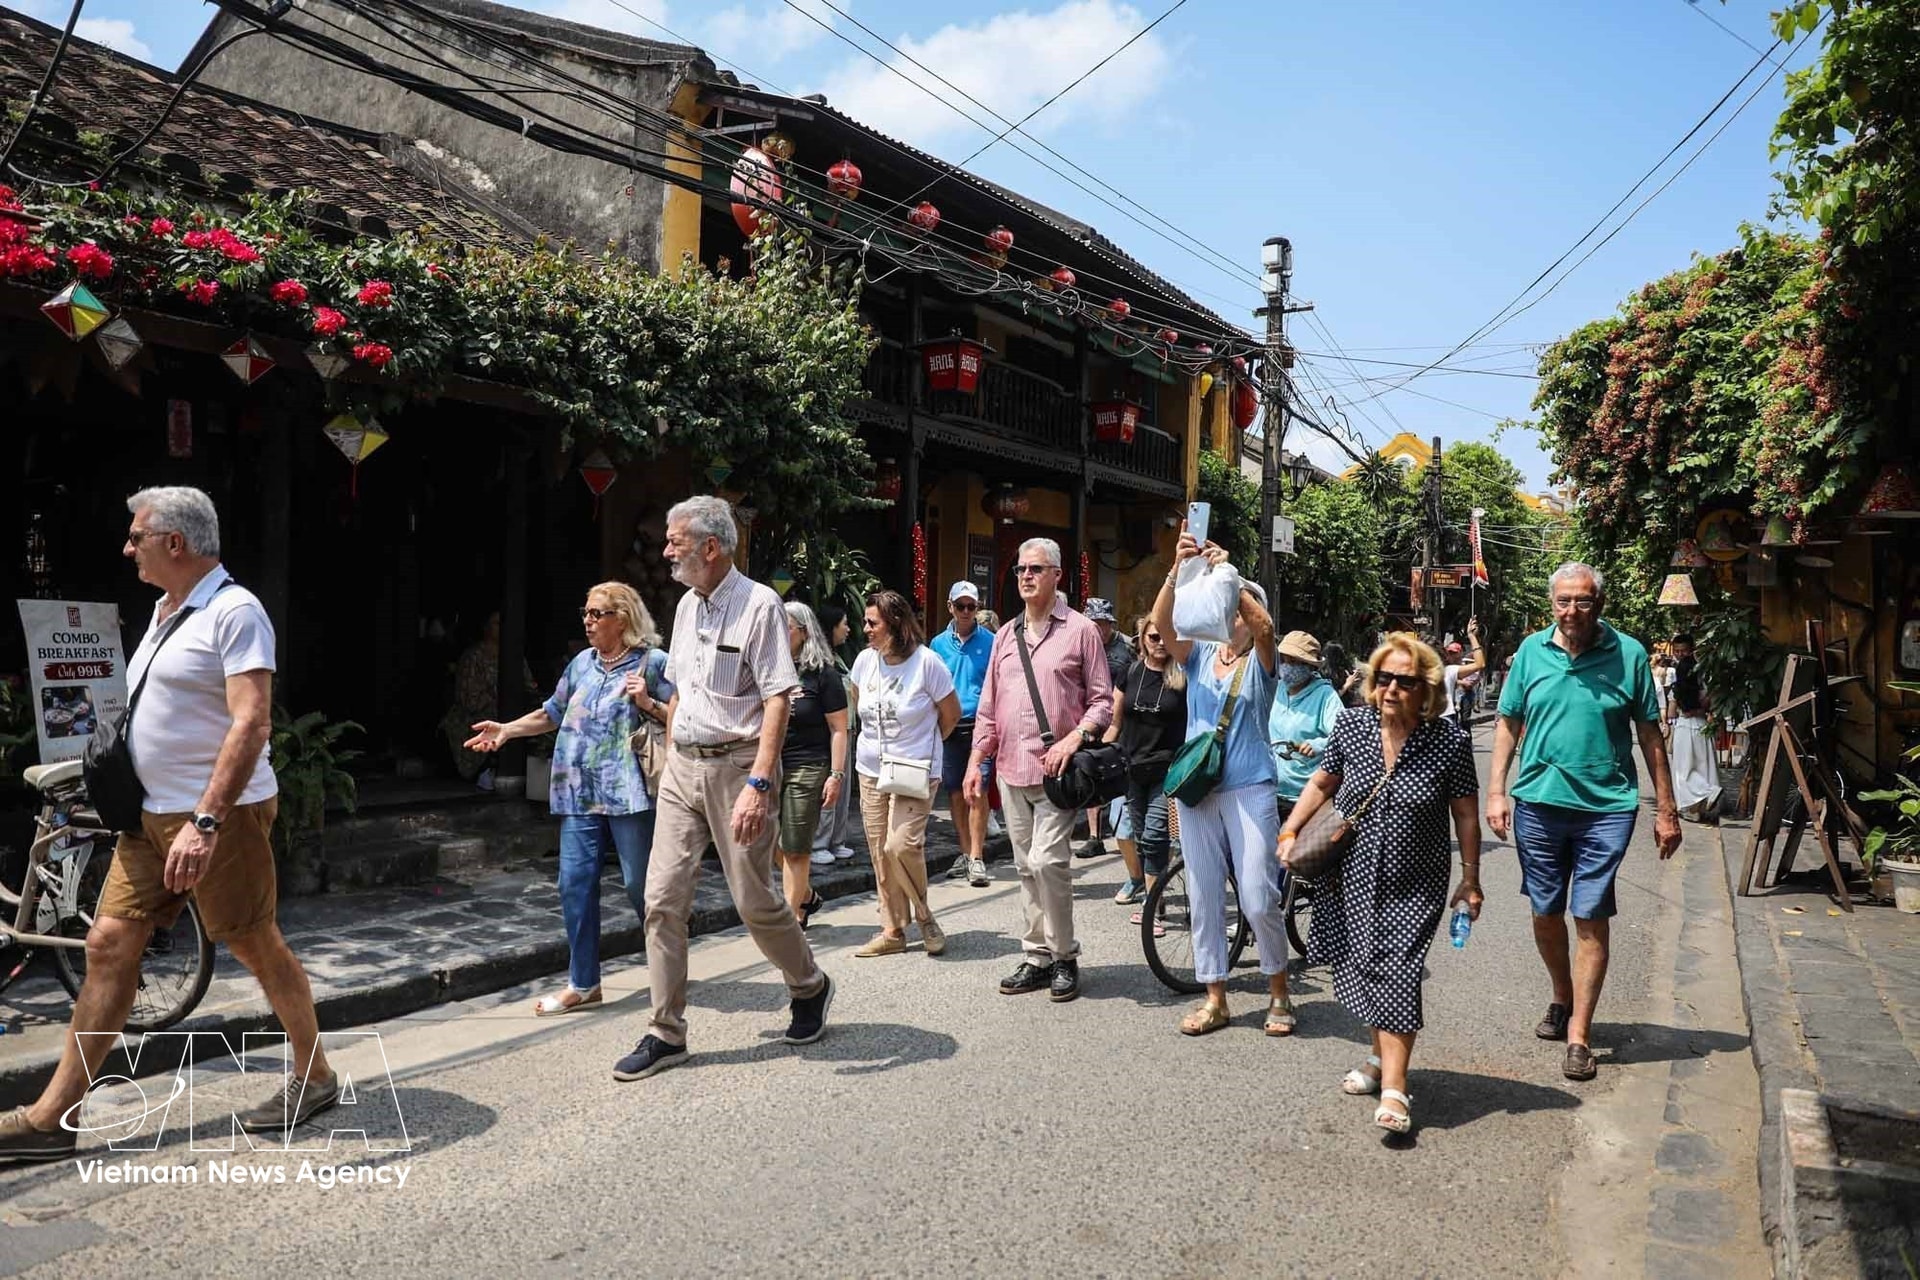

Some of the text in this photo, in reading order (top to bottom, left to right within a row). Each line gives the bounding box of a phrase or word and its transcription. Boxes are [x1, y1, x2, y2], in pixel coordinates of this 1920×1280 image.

[52, 632, 100, 644] COMBO
[38, 647, 115, 659] BREAKFAST
[58, 665, 104, 679] Only 99K
